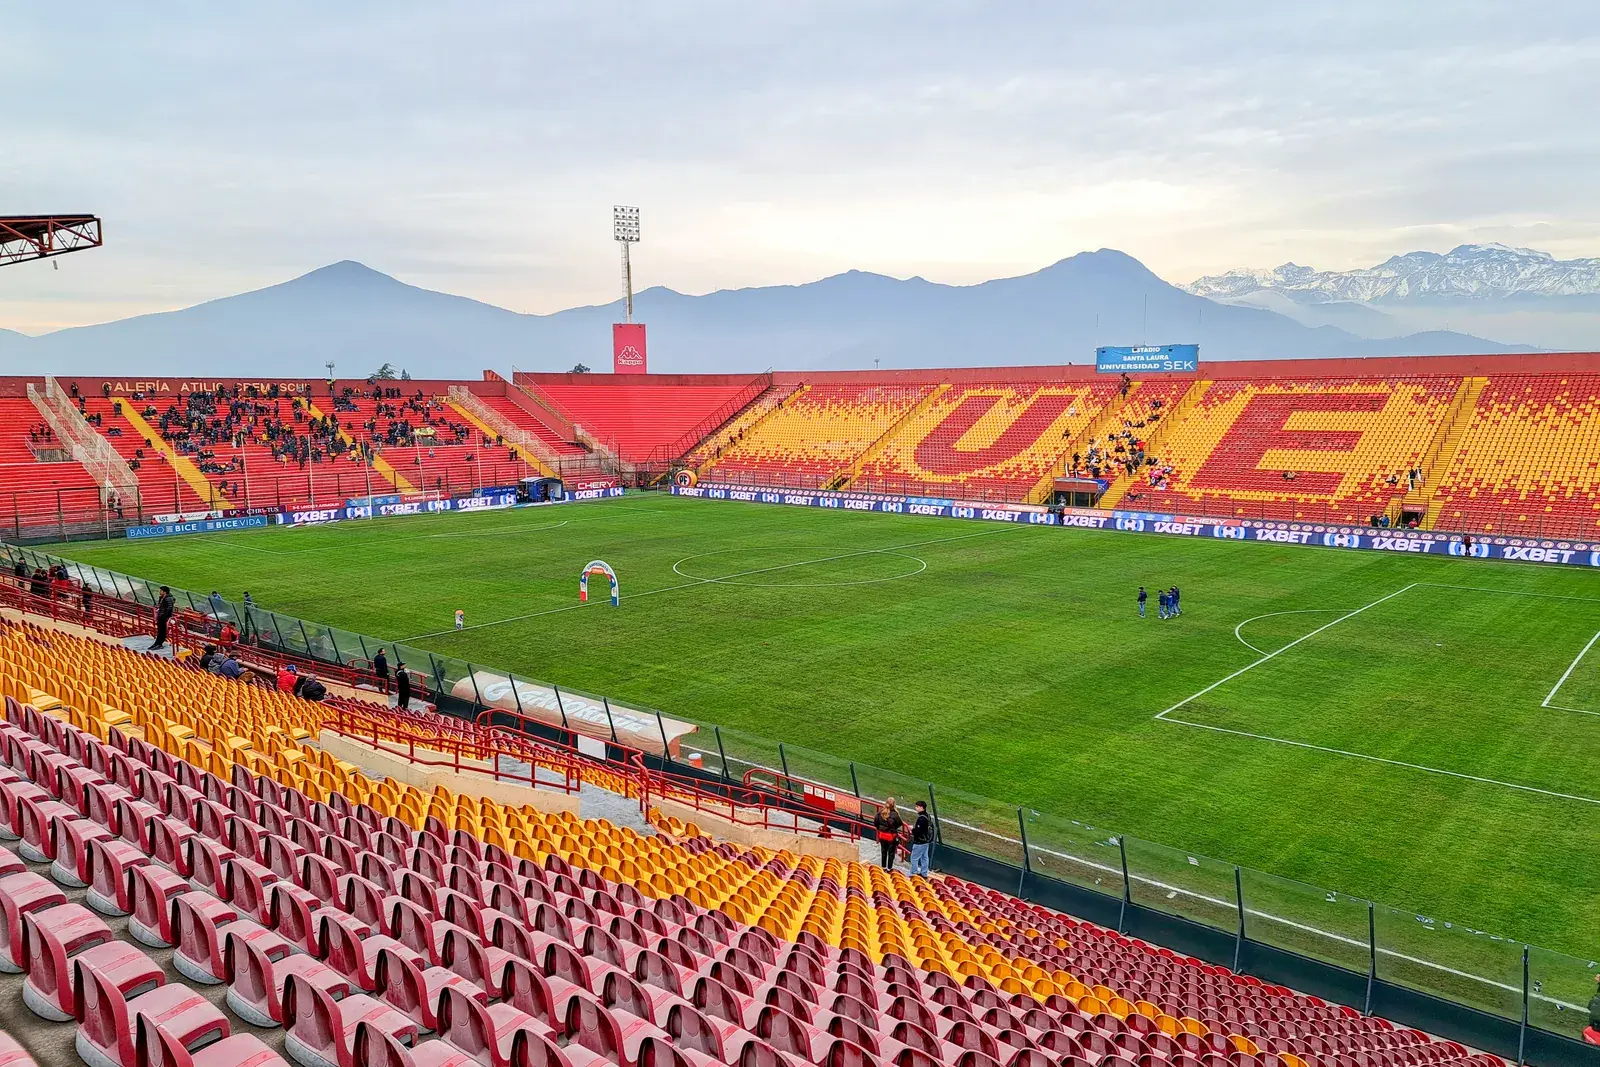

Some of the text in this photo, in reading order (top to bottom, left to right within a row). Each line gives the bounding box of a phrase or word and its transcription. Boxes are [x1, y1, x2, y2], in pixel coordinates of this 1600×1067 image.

[1163, 360, 1195, 370] SEK
[101, 380, 171, 392] GALERÍA
[577, 480, 615, 490] CHERY
[574, 488, 605, 500] 1XBET
[679, 487, 705, 497] 1XBET
[729, 490, 758, 501] 1XBET
[457, 496, 494, 509] 1XBET
[784, 494, 814, 506] 1XBET
[843, 499, 876, 511] 1XBET
[954, 501, 1002, 509] CHERY
[380, 502, 420, 515] 1XBET
[908, 504, 945, 516] 1XBET
[292, 509, 338, 523] 1XBET
[981, 509, 1022, 522] 1XBET
[1185, 516, 1227, 526] CHERY
[215, 518, 262, 530] BICE VIDA
[1062, 515, 1107, 529] 1XBET
[129, 523, 198, 538] BANCO BICE
[1153, 521, 1204, 536] 1XBET
[1255, 528, 1313, 544] 1XBET
[1371, 536, 1436, 553] 1XBET
[1502, 546, 1576, 564] 1XBET
